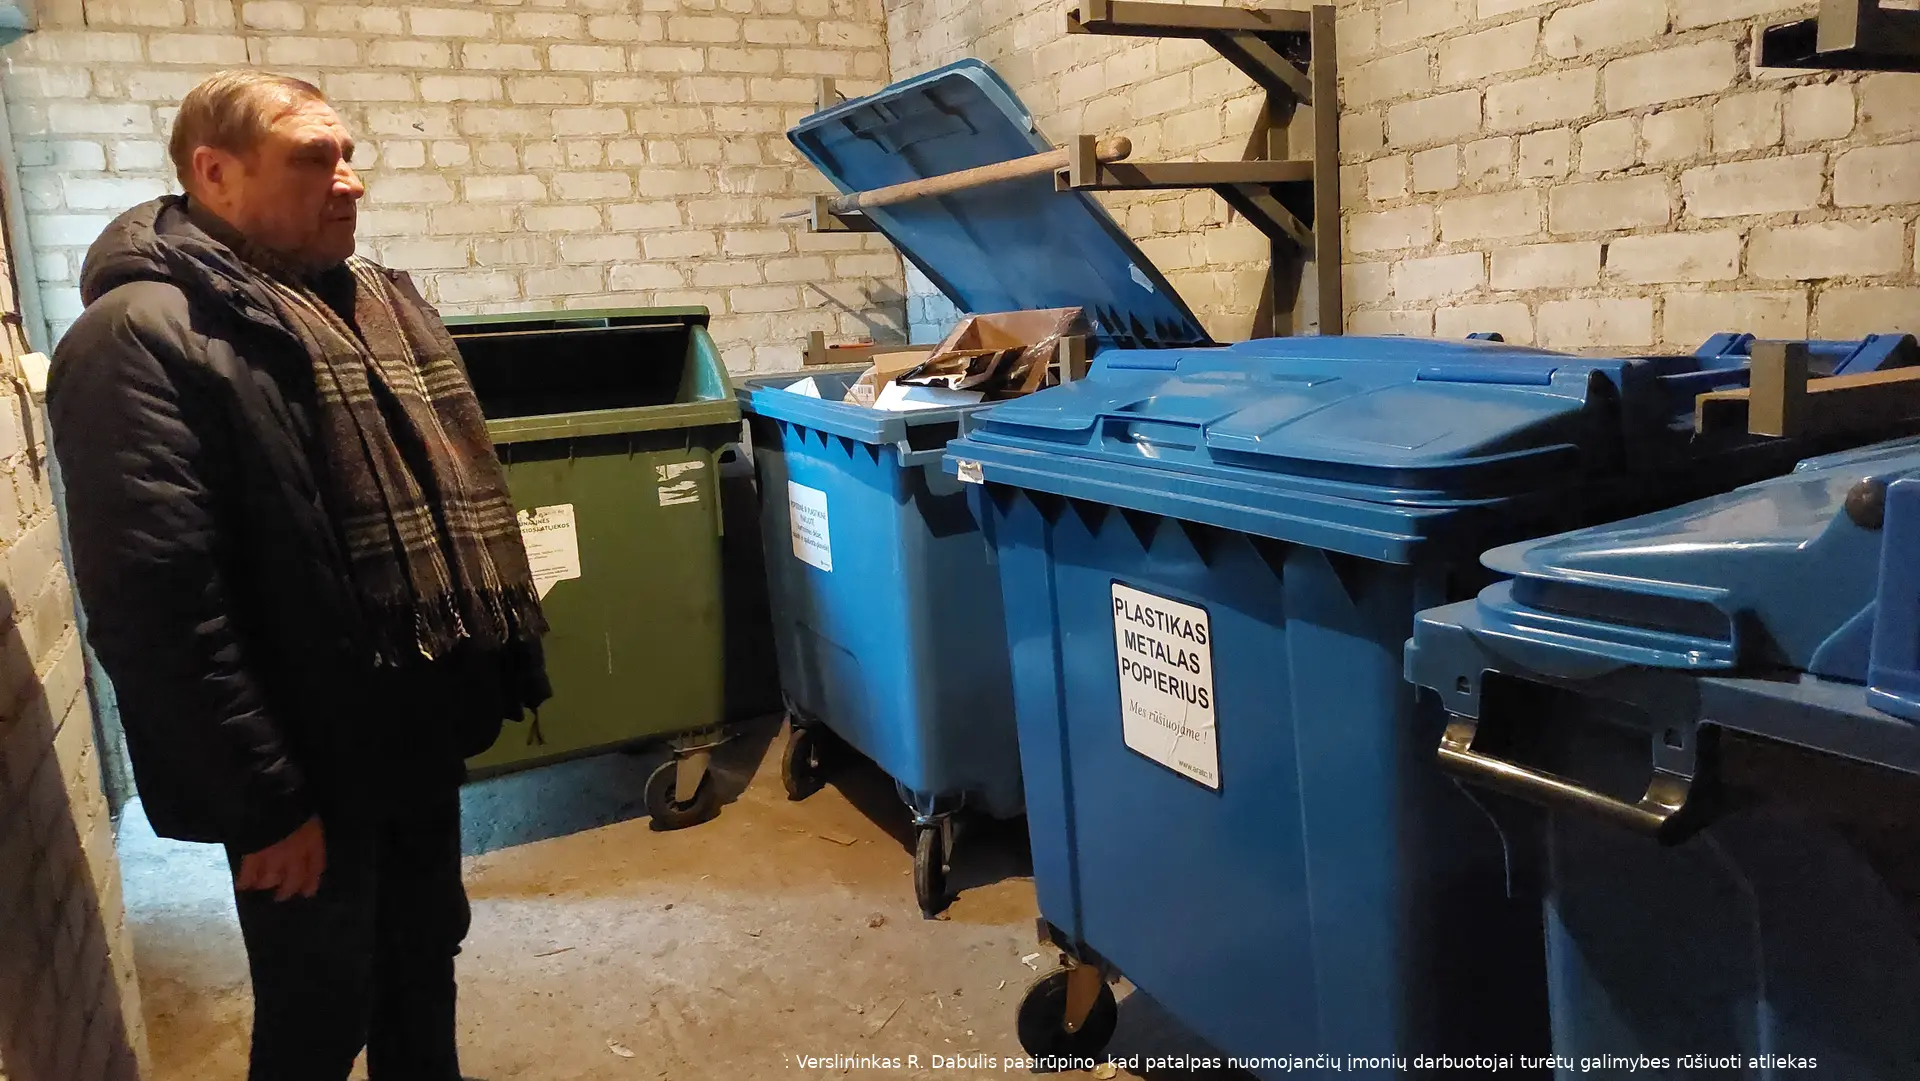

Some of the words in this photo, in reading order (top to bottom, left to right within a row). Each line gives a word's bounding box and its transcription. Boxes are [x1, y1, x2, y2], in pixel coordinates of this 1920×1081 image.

[1114, 597, 1207, 645] PLASTIKAS
[1124, 629, 1200, 675] METALAS
[1121, 656, 1210, 709] POPIERIUS
[1129, 699, 1147, 719] Mes
[1149, 709, 1201, 742] rūšiuojame
